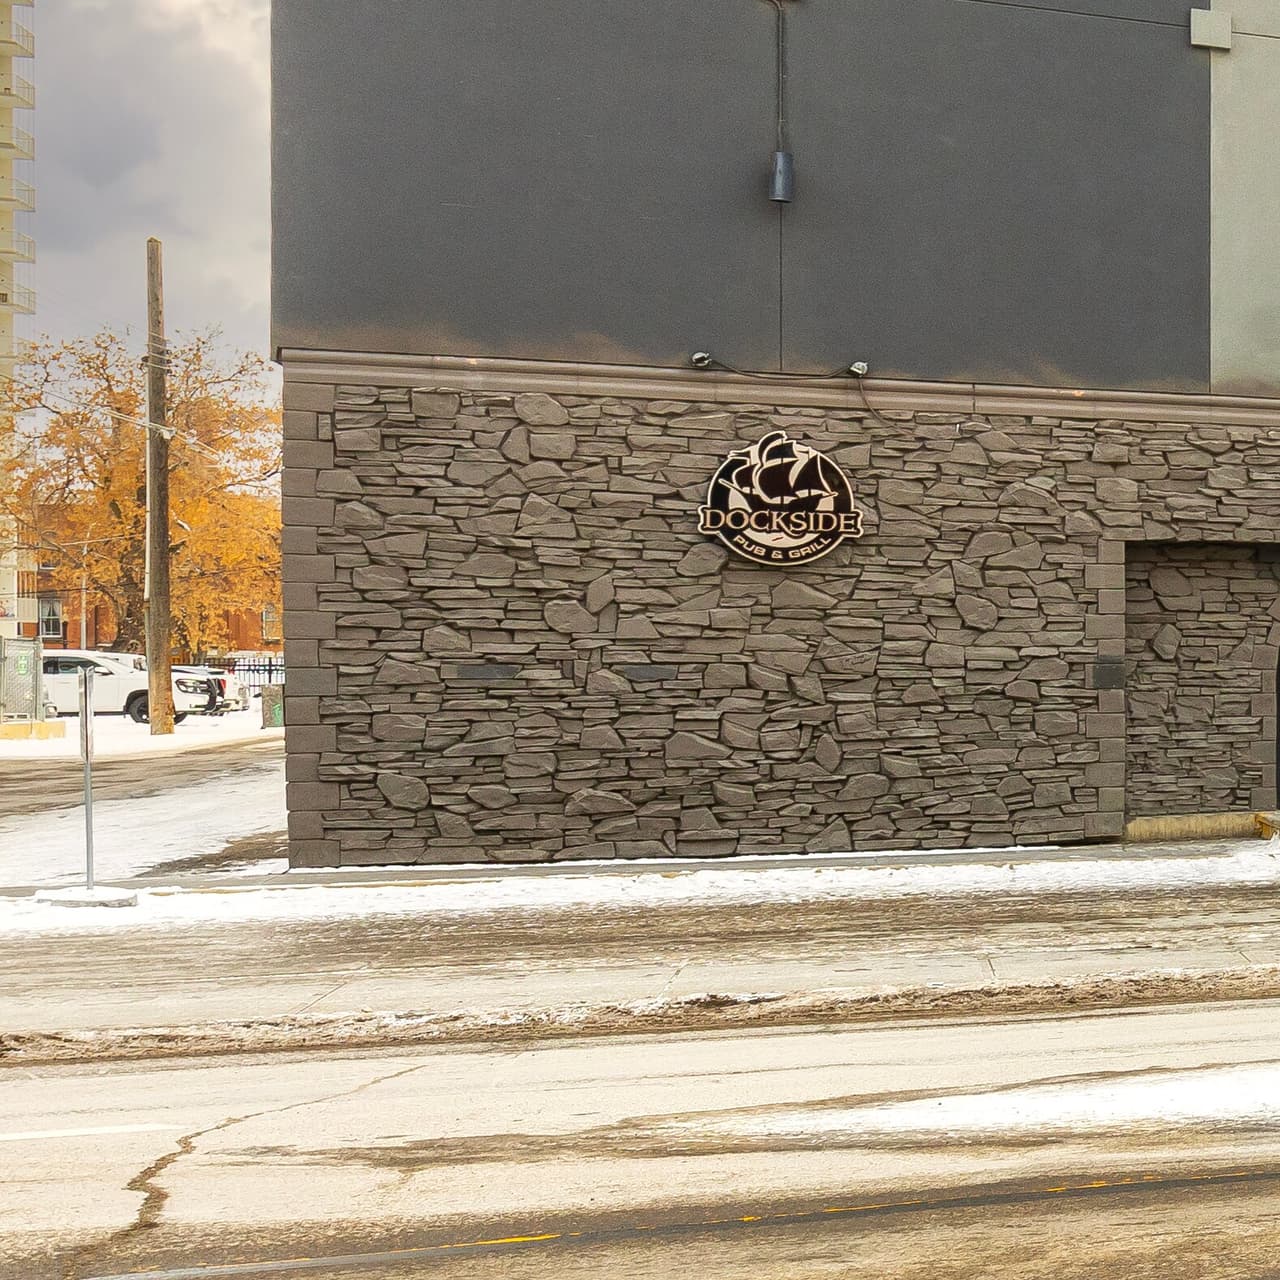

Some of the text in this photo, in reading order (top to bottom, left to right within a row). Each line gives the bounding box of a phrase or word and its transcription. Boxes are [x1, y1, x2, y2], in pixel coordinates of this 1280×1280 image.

[703, 509, 858, 536] DOCKSIDE
[733, 535, 832, 559] PUB & GRILL
